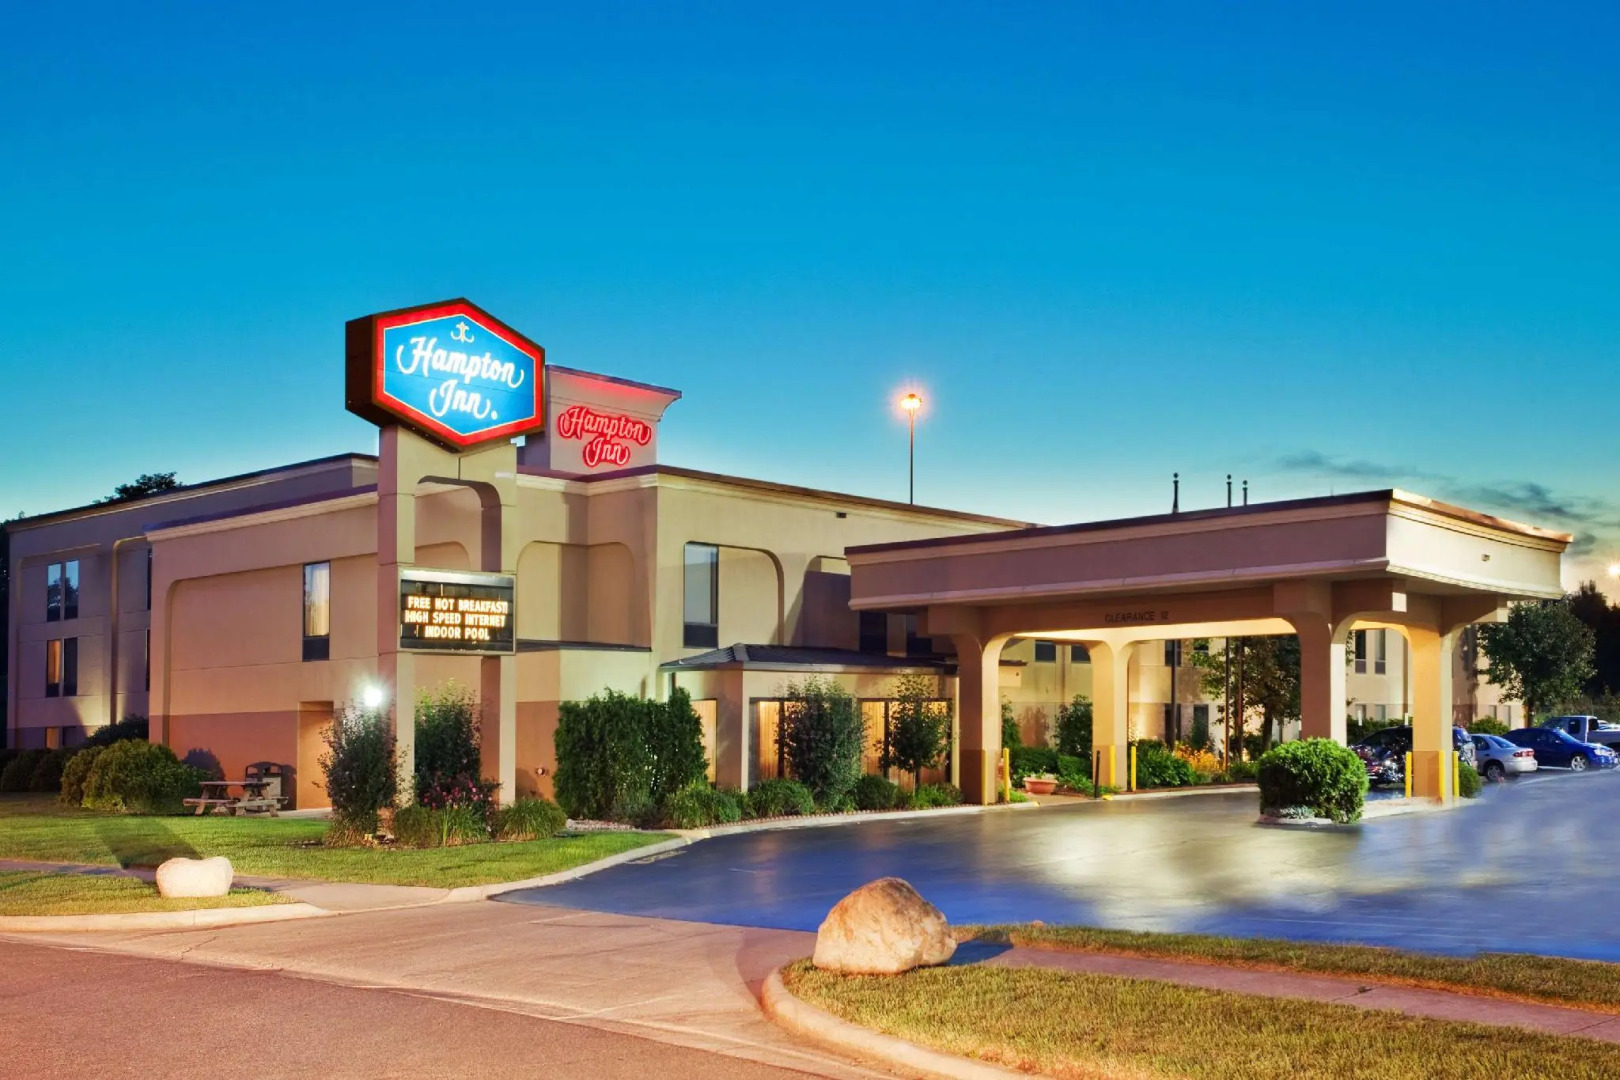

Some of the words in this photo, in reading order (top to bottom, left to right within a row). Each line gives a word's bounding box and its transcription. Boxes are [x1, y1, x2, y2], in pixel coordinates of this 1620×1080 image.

[397, 336, 524, 388] Hampton
[559, 405, 652, 444] Hampton
[583, 437, 631, 467] Inn
[407, 596, 431, 609] FREE
[435, 598, 455, 611] HOT
[405, 610, 429, 623] HIGH
[433, 612, 461, 624] SPEED
[465, 613, 506, 628] INTERNET
[1105, 611, 1155, 623] CLEARANCE
[425, 625, 461, 638] INDOOR
[464, 627, 490, 640] POOL
